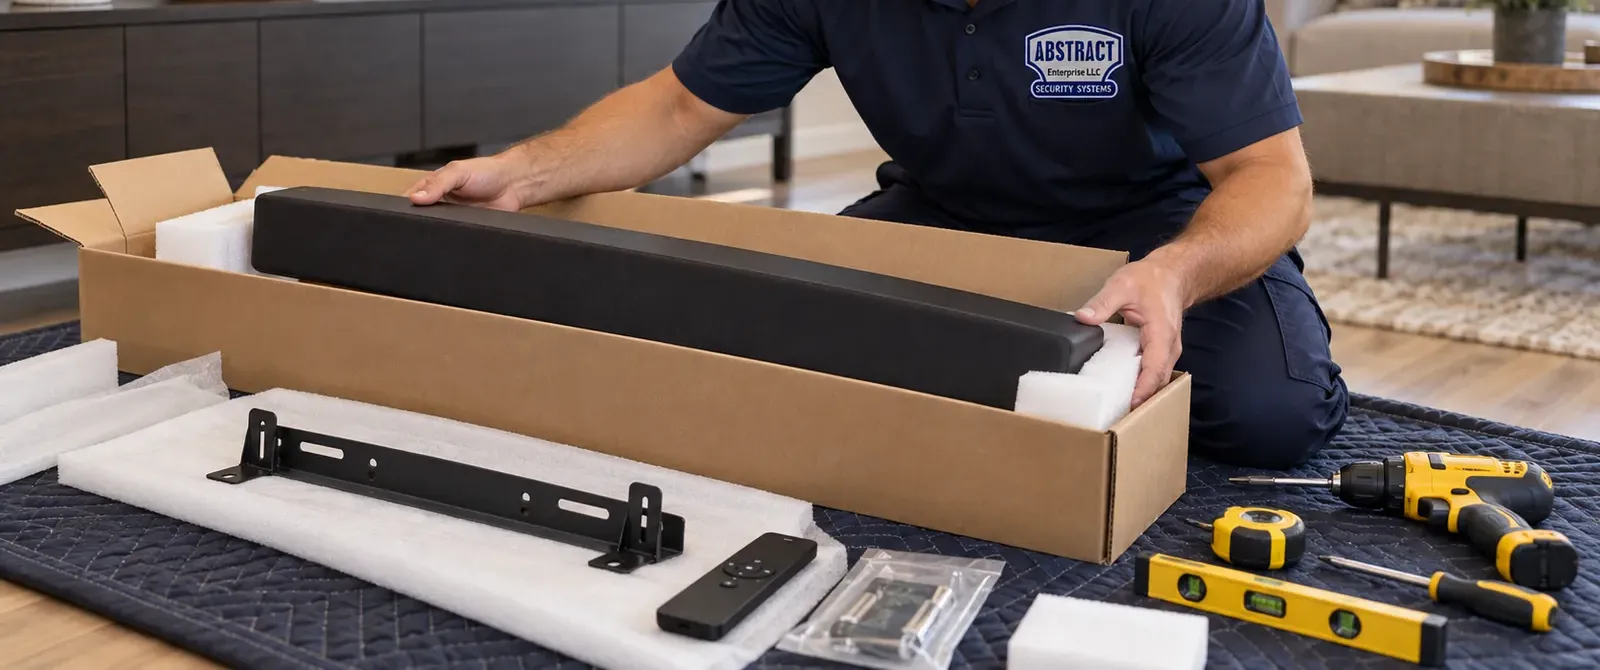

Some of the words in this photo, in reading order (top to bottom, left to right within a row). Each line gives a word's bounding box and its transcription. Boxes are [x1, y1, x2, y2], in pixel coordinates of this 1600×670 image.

[1034, 40, 1115, 62] ABSTRACT
[1047, 68, 1086, 78] Enterprise
[1086, 68, 1101, 76] LLC
[1035, 84, 1074, 93] SECURITY
[1076, 84, 1112, 93] SYSTEMS
